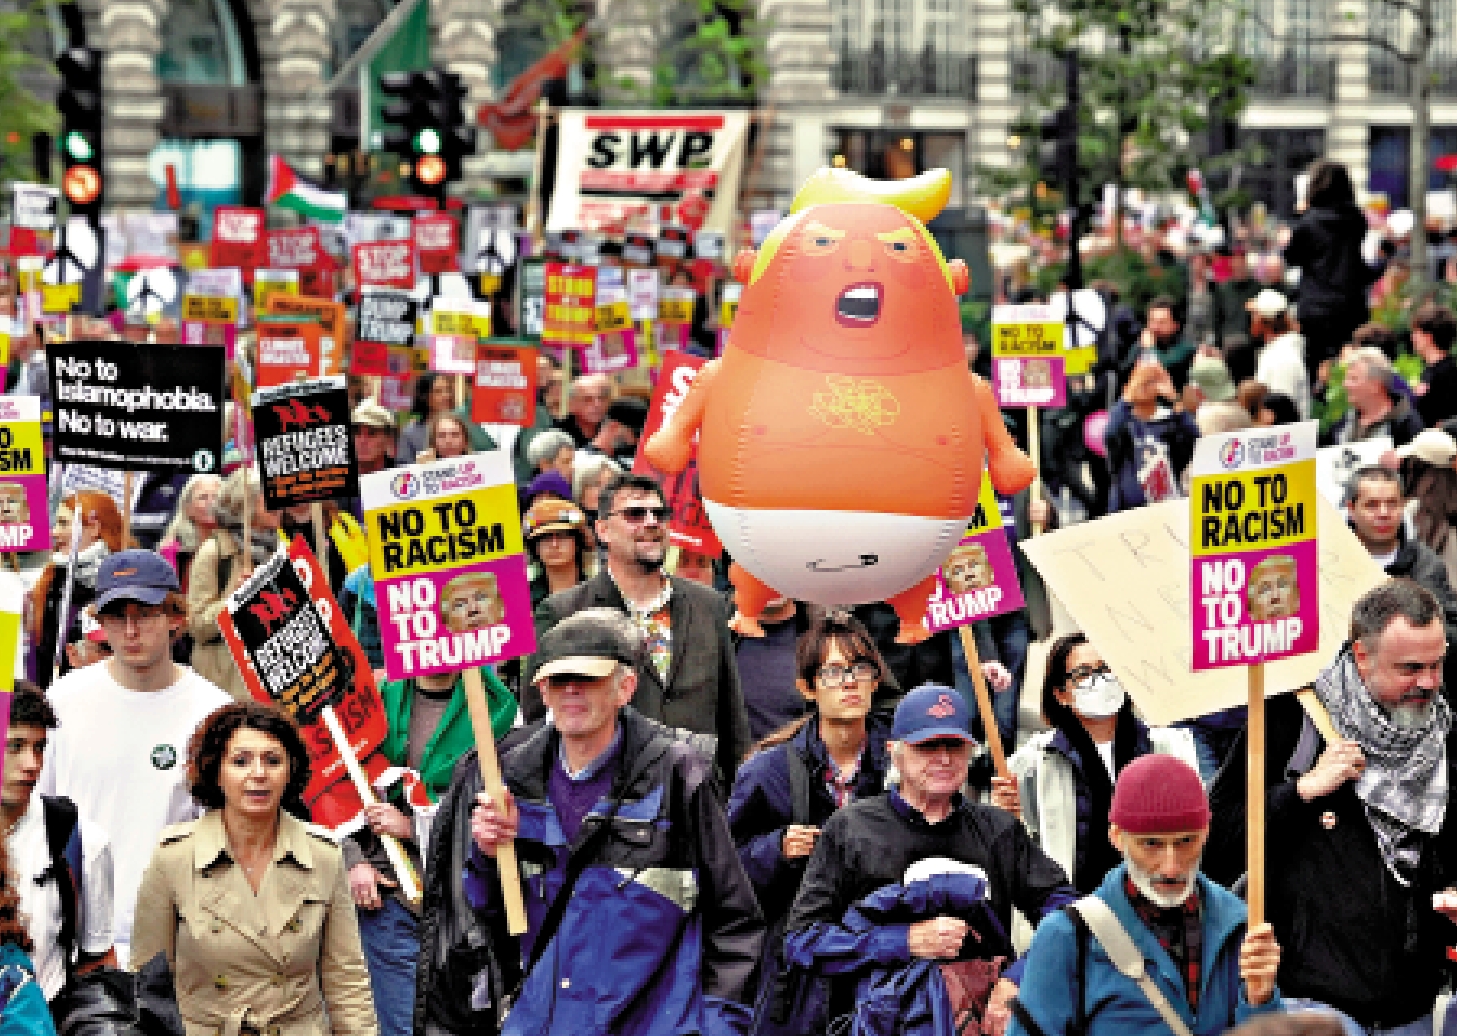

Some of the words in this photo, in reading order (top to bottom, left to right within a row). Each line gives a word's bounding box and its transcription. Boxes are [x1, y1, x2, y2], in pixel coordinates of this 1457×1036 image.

[587, 131, 714, 169] SWP
[55, 356, 92, 379] No
[94, 356, 118, 382] to
[57, 379, 217, 413] Islamophobia.
[58, 408, 91, 433] No
[95, 412, 116, 437] to
[119, 420, 169, 442] war.
[262, 424, 348, 458] REFUGEES
[263, 443, 351, 478] WELCOME
[1202, 480, 1245, 515] NO
[1252, 473, 1288, 507] TO
[377, 507, 425, 542] NO
[432, 499, 478, 534] TO
[1201, 502, 1305, 549] RACISM
[382, 523, 505, 573] RACISM
[386, 577, 437, 613] NO
[1201, 558, 1245, 595] NO
[390, 610, 438, 643] TO
[1201, 593, 1244, 629] TO
[253, 602, 321, 670] REFUGEES
[394, 624, 512, 674] TRUMP
[1201, 616, 1303, 664] TRUMP
